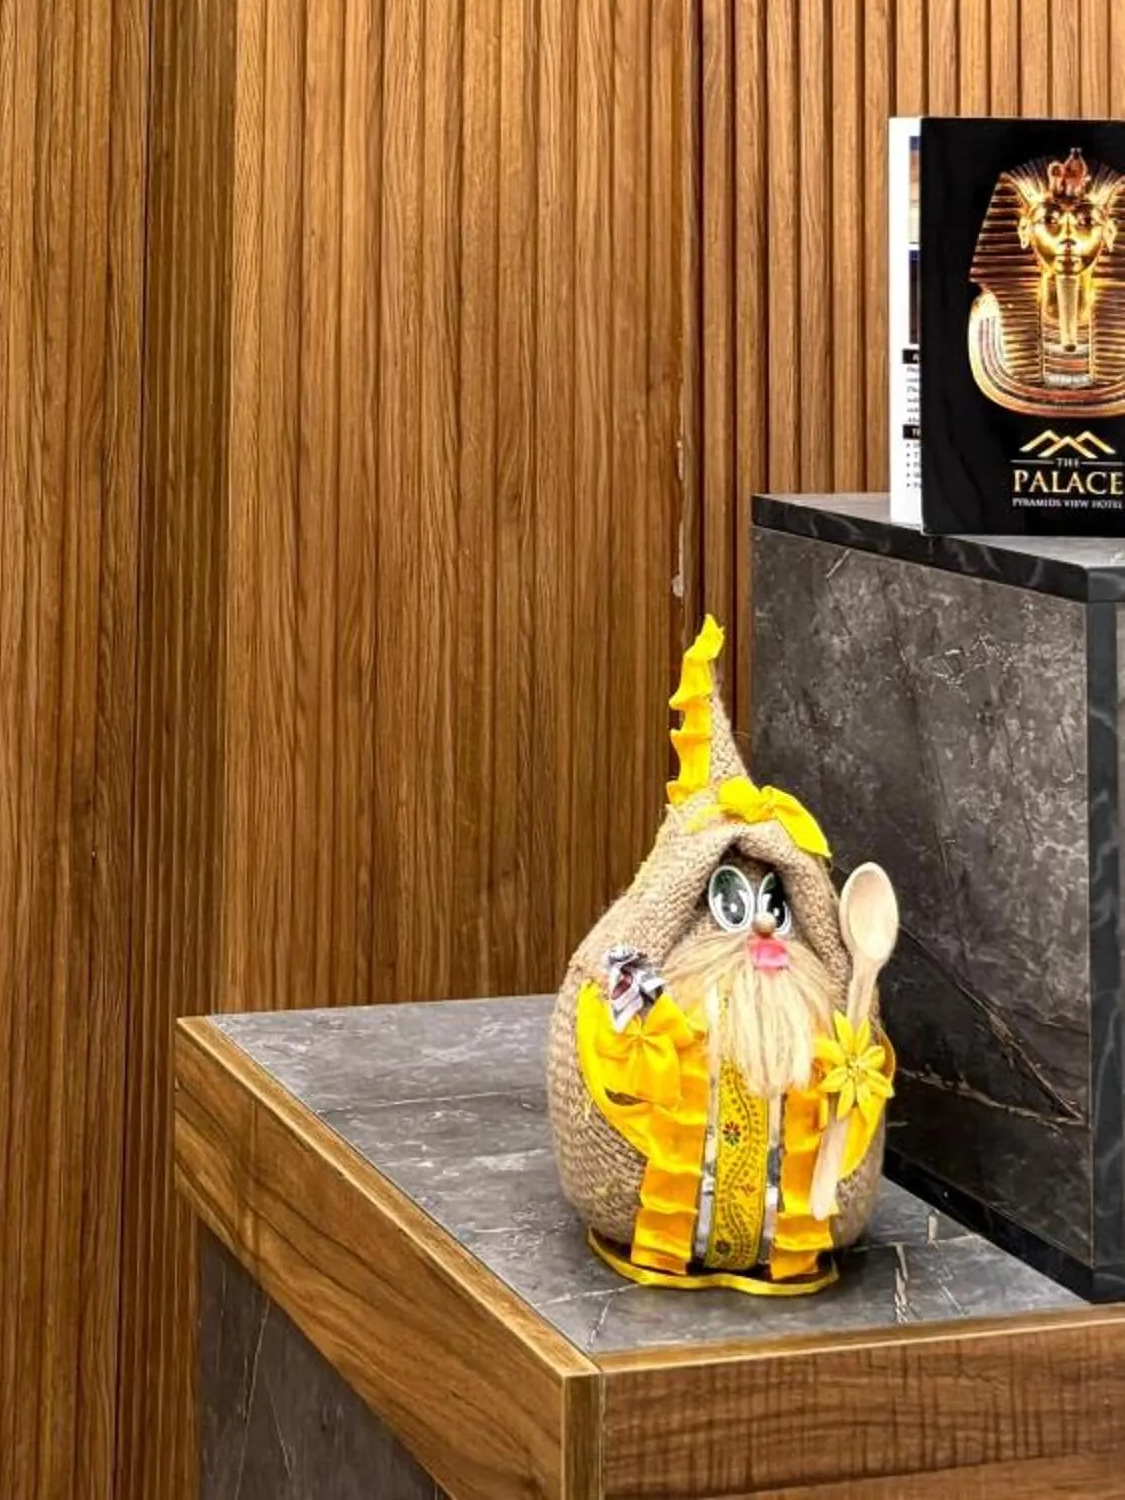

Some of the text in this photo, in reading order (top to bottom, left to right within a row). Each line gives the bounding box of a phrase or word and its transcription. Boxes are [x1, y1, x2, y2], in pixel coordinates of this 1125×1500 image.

[1056, 457, 1080, 468] THE
[1012, 468, 1124, 495] PALACE
[1063, 499, 1089, 509] VIEW
[1091, 499, 1124, 510] HOTEL
